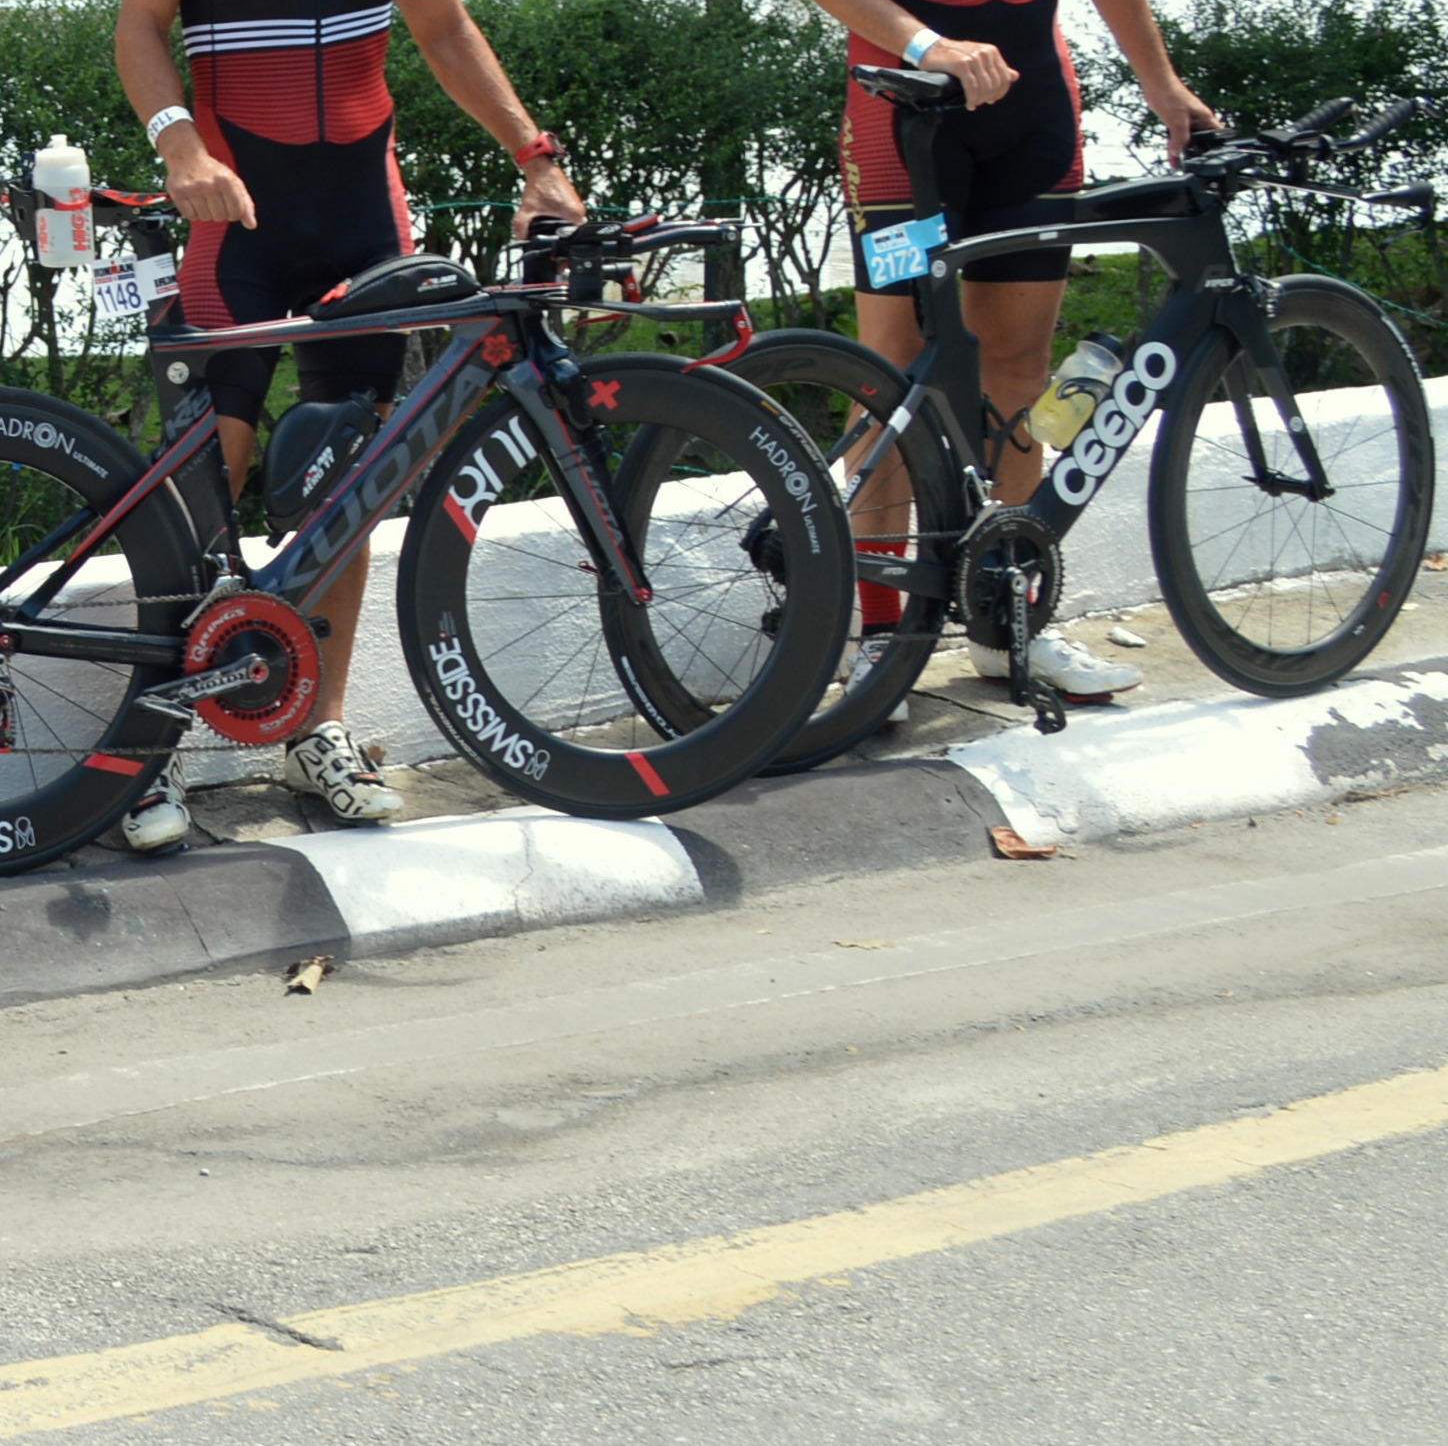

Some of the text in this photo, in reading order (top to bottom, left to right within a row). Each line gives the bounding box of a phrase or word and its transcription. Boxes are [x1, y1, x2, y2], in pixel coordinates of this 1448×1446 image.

[871, 246, 924, 284] 2172
[96, 281, 142, 314] 1148
[72, 450, 110, 480] ULTIMATE
[283, 365, 494, 590] KUOTA
[749, 426, 822, 554] HADRON ULTIMATE
